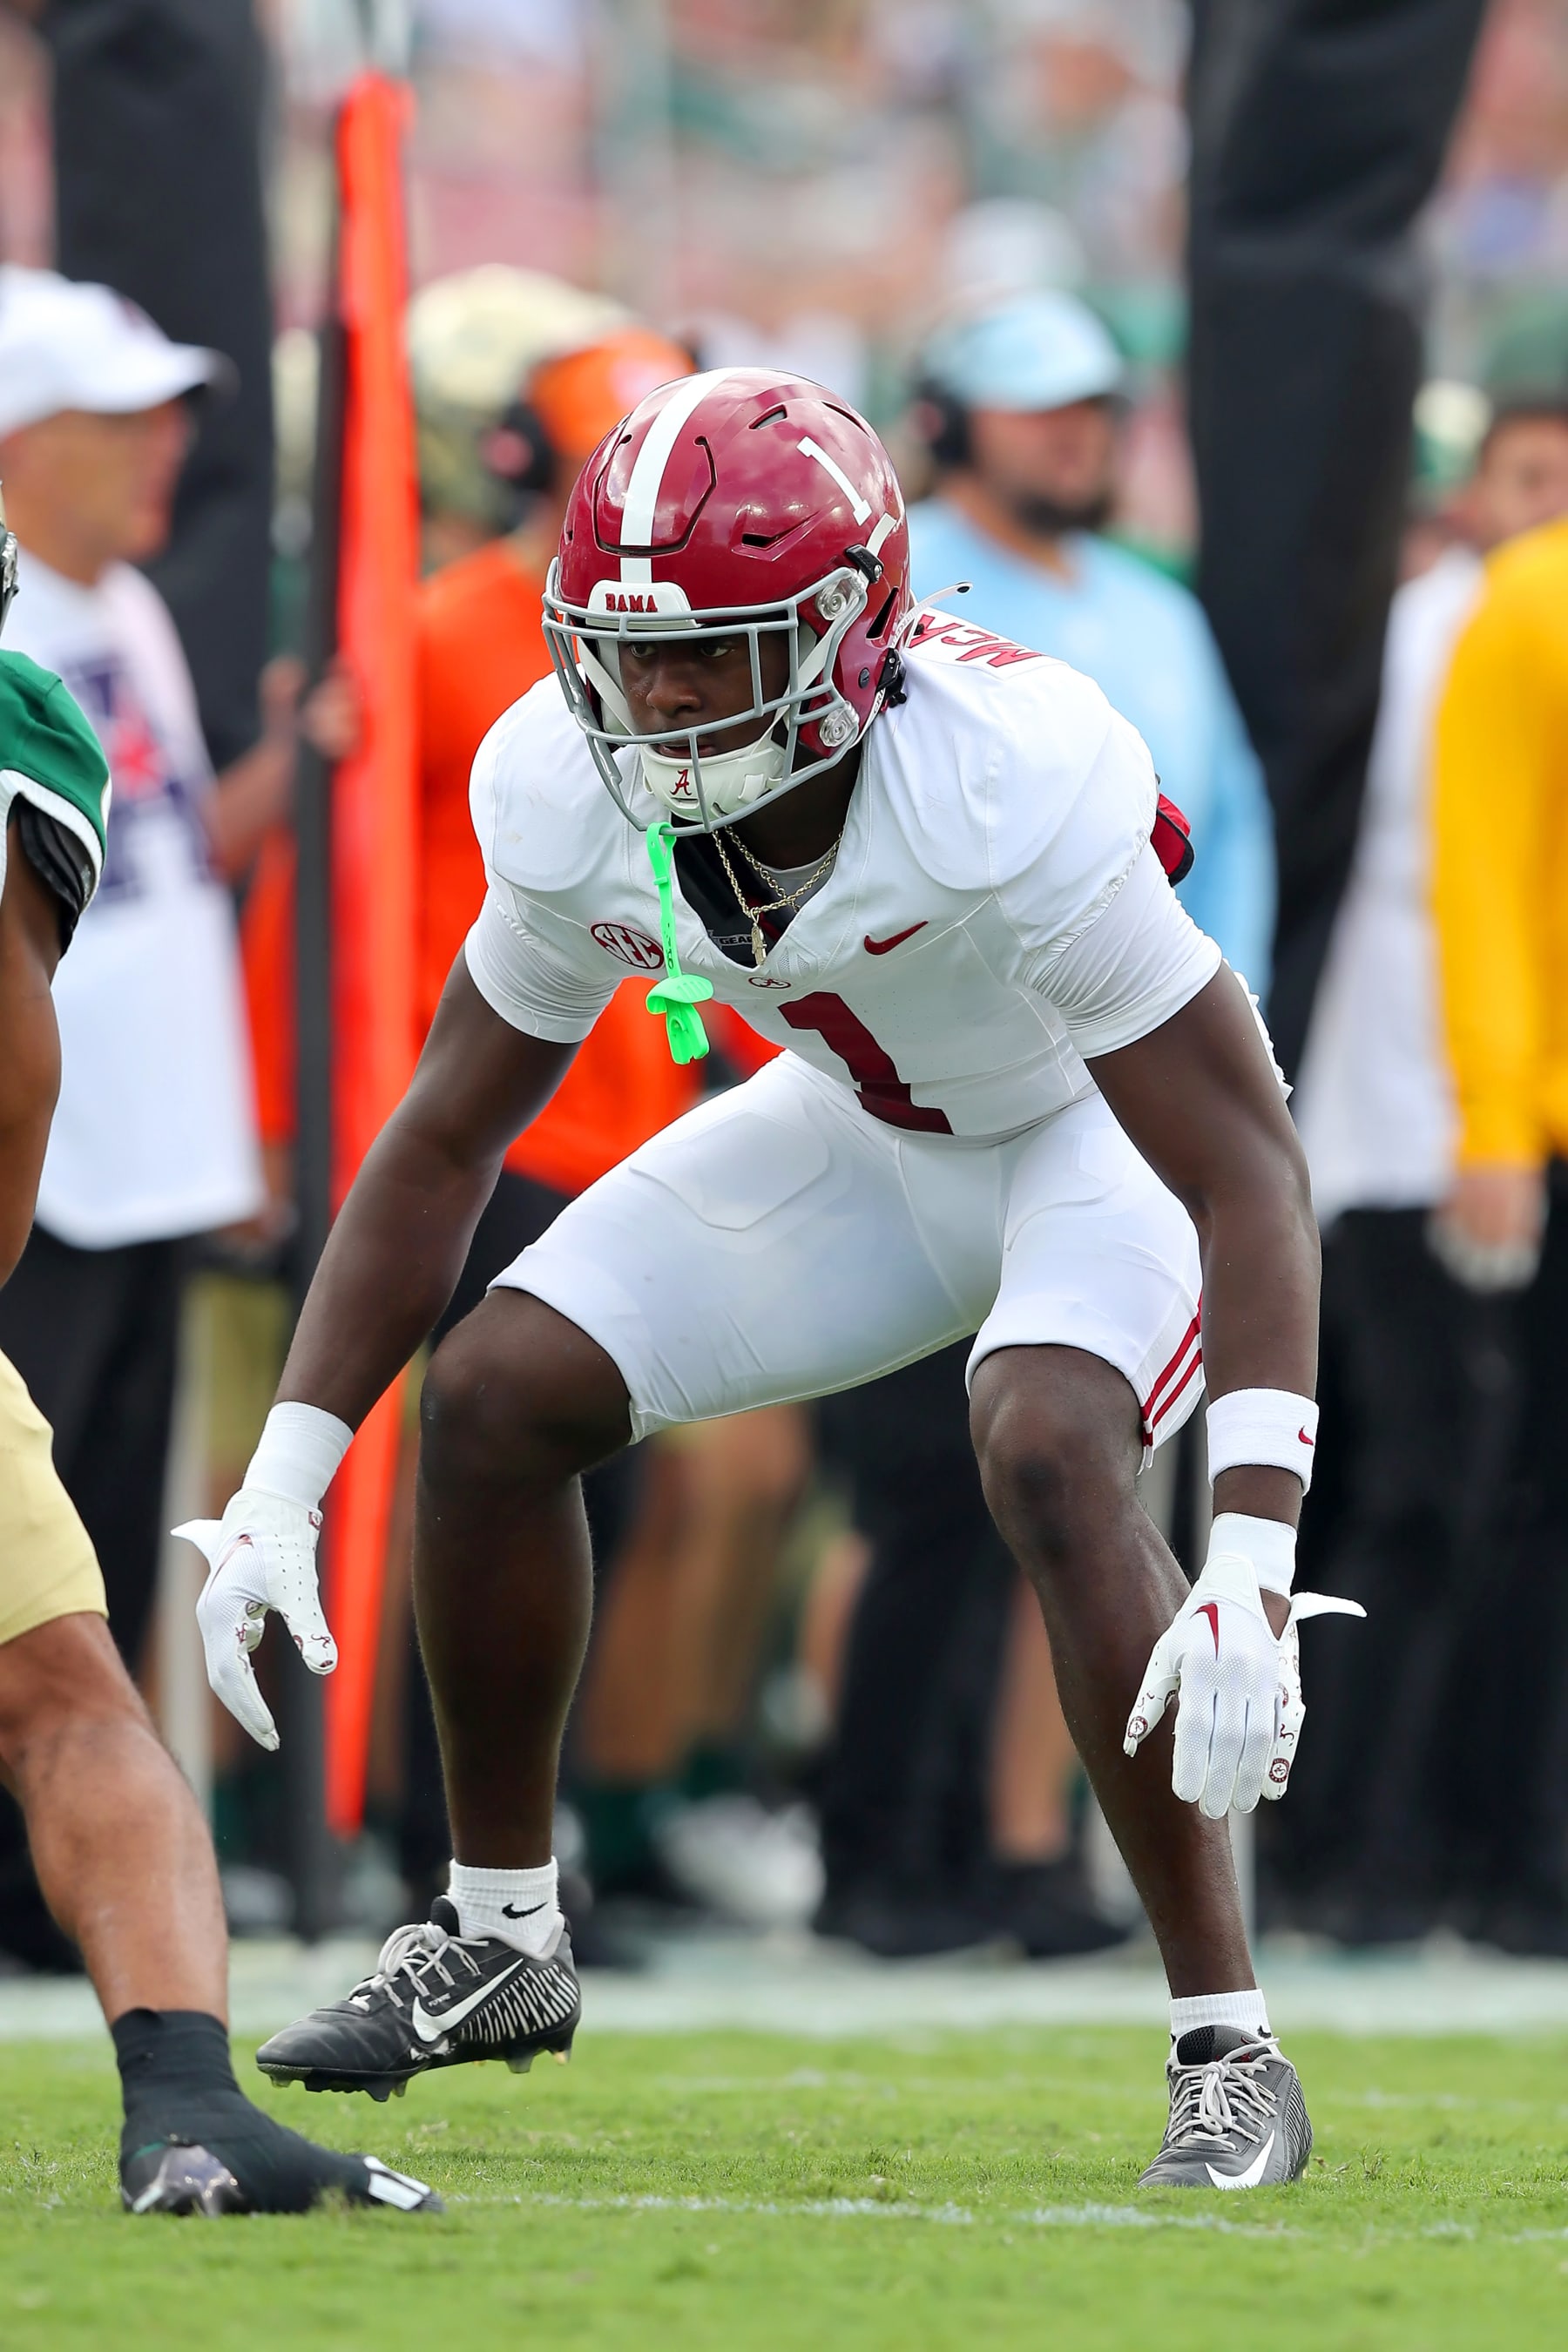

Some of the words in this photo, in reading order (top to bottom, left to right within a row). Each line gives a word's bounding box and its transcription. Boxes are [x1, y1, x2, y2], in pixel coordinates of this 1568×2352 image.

[796, 436, 873, 526] 1
[605, 592, 658, 612] BAMA
[670, 768, 693, 796] A
[593, 924, 660, 968] SEC
[777, 990, 955, 1136] 1
